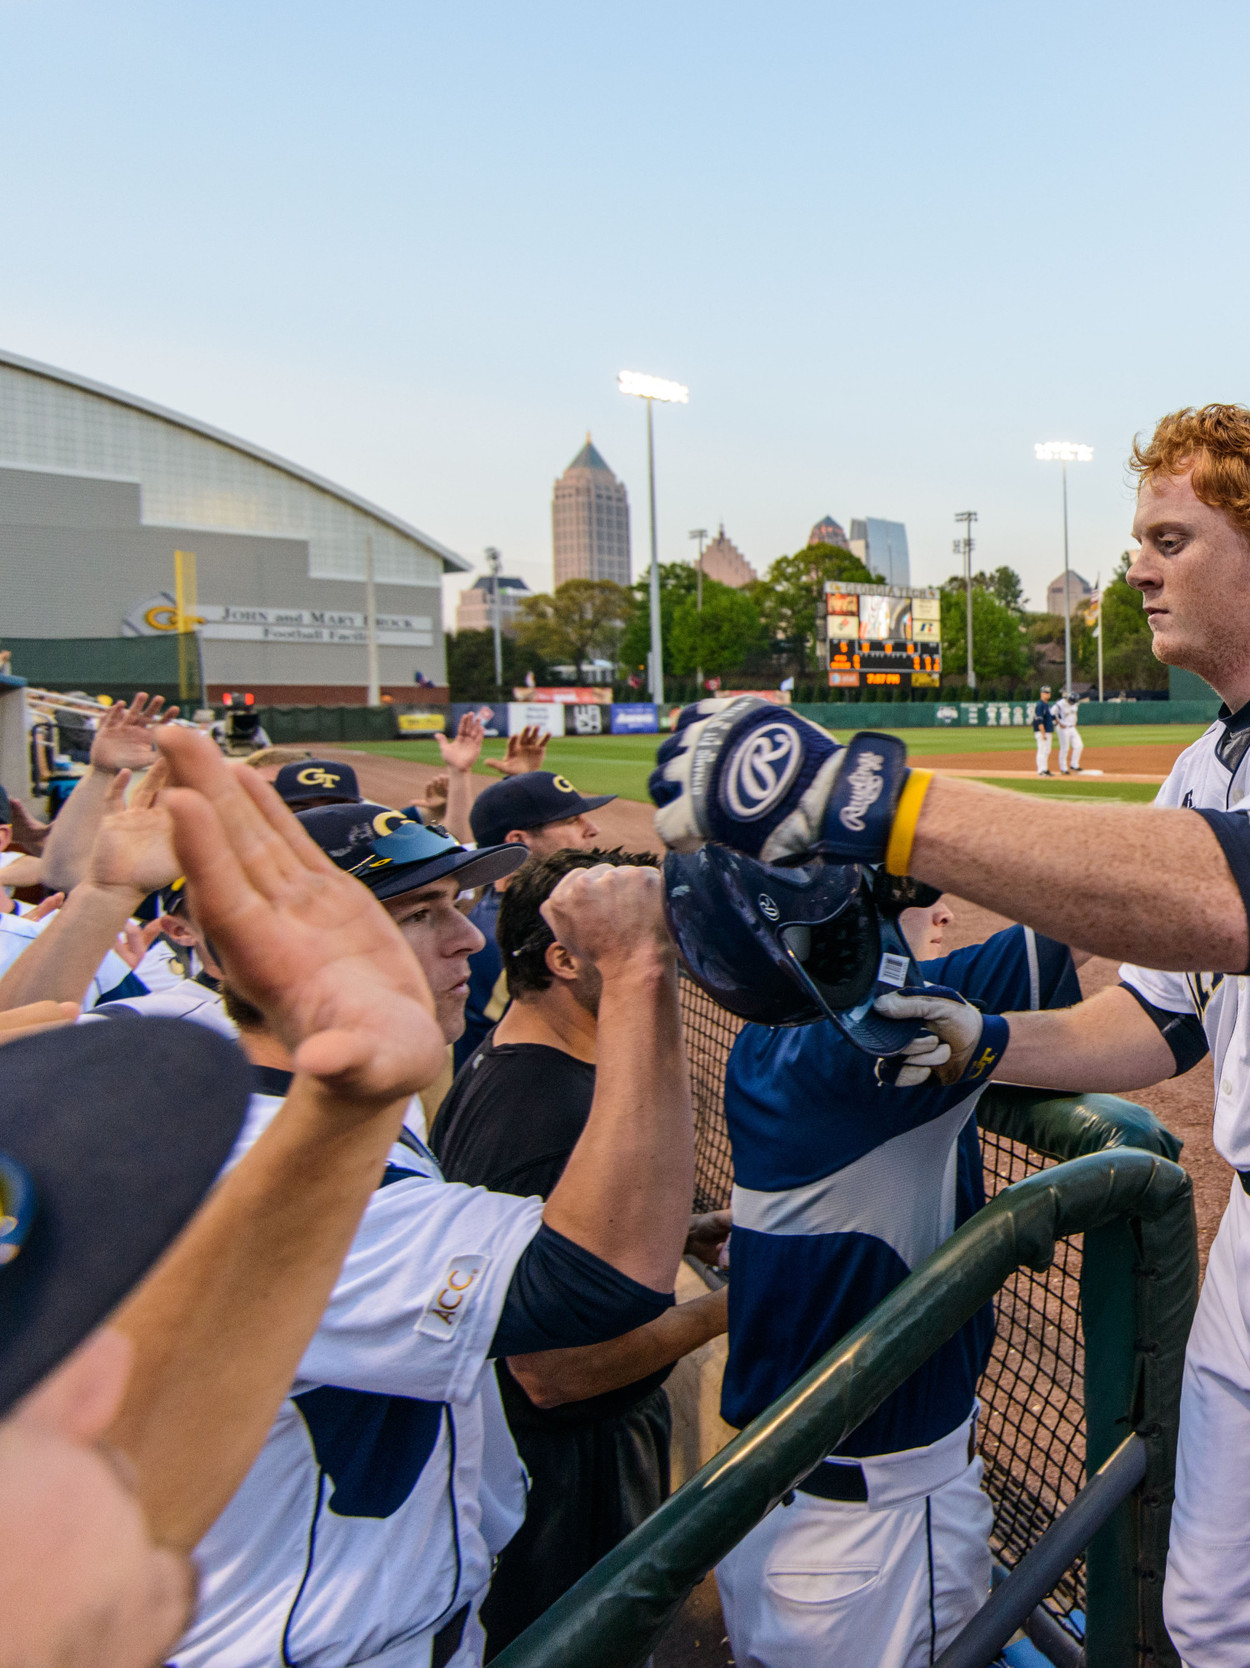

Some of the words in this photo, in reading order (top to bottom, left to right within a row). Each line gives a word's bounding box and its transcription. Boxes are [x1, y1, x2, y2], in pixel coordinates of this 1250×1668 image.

[221, 606, 270, 624] JOHN
[274, 611, 303, 625] and
[310, 611, 356, 627] MARY
[263, 627, 323, 641] Football
[296, 767, 341, 789] GT
